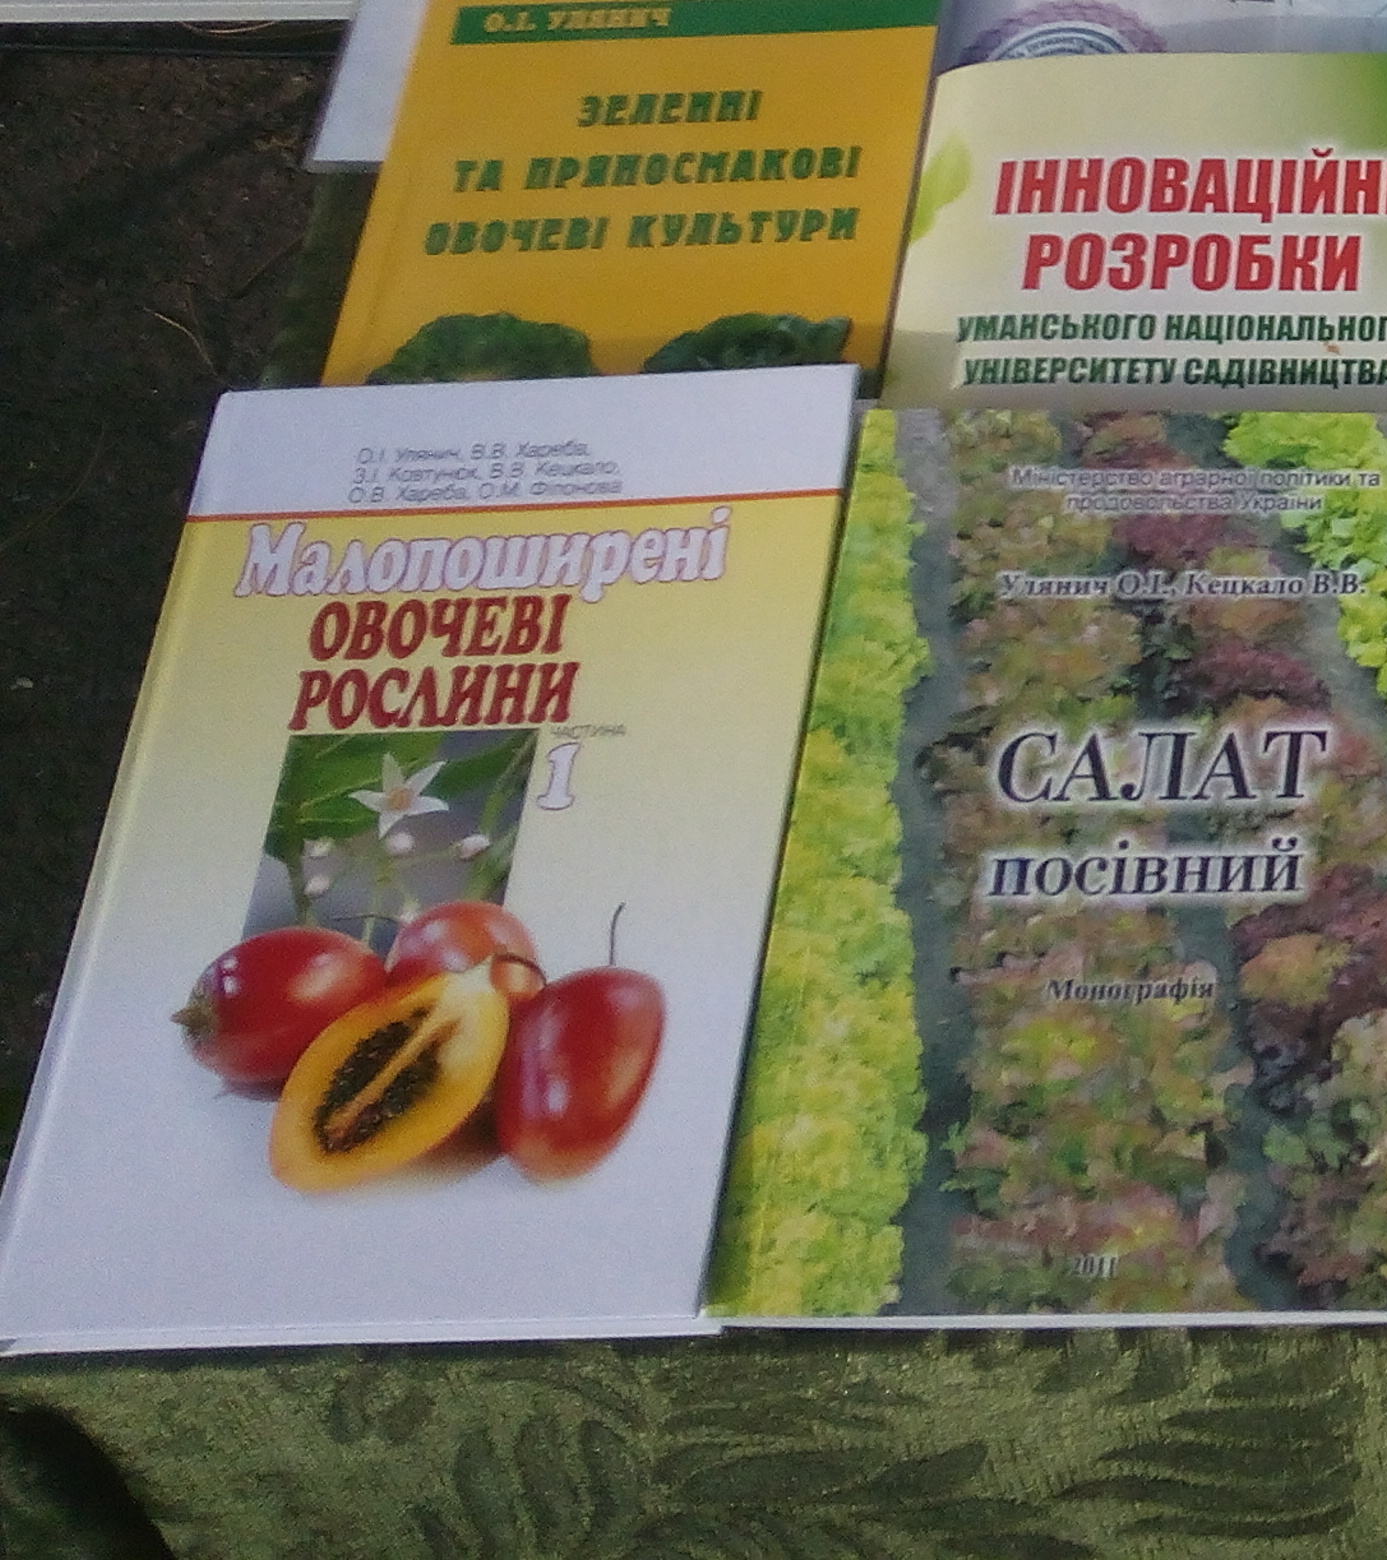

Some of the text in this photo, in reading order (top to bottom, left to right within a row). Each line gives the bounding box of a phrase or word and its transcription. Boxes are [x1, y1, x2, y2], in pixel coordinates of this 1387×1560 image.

[577, 89, 764, 128] ЗЕЛЕННІ
[453, 145, 863, 193] ТА ПРЯНОСМАКОВІ
[423, 206, 861, 255] ОВОЧЕВІ КУЛЬТУРИ
[1021, 232, 1363, 292] РОЗРОБКИ
[955, 312, 1157, 344] УМАНСЬКОГО
[961, 357, 1177, 388] УНІВЕРСИТЕТУ
[1011, 467, 1353, 494] Міністерство аграрної політики
[1238, 492, 1324, 514] України
[234, 506, 733, 603] Малопоширені
[999, 570, 1367, 599] Улянич Кецкало В.В.
[309, 593, 573, 662] ОВОЧЕВІ
[288, 662, 581, 732] РОСЛИНИ
[536, 741, 581, 811] 1
[997, 729, 1328, 803] САЛАТ
[986, 837, 1305, 899] посівний
[1046, 977, 1214, 1005] Монографія
